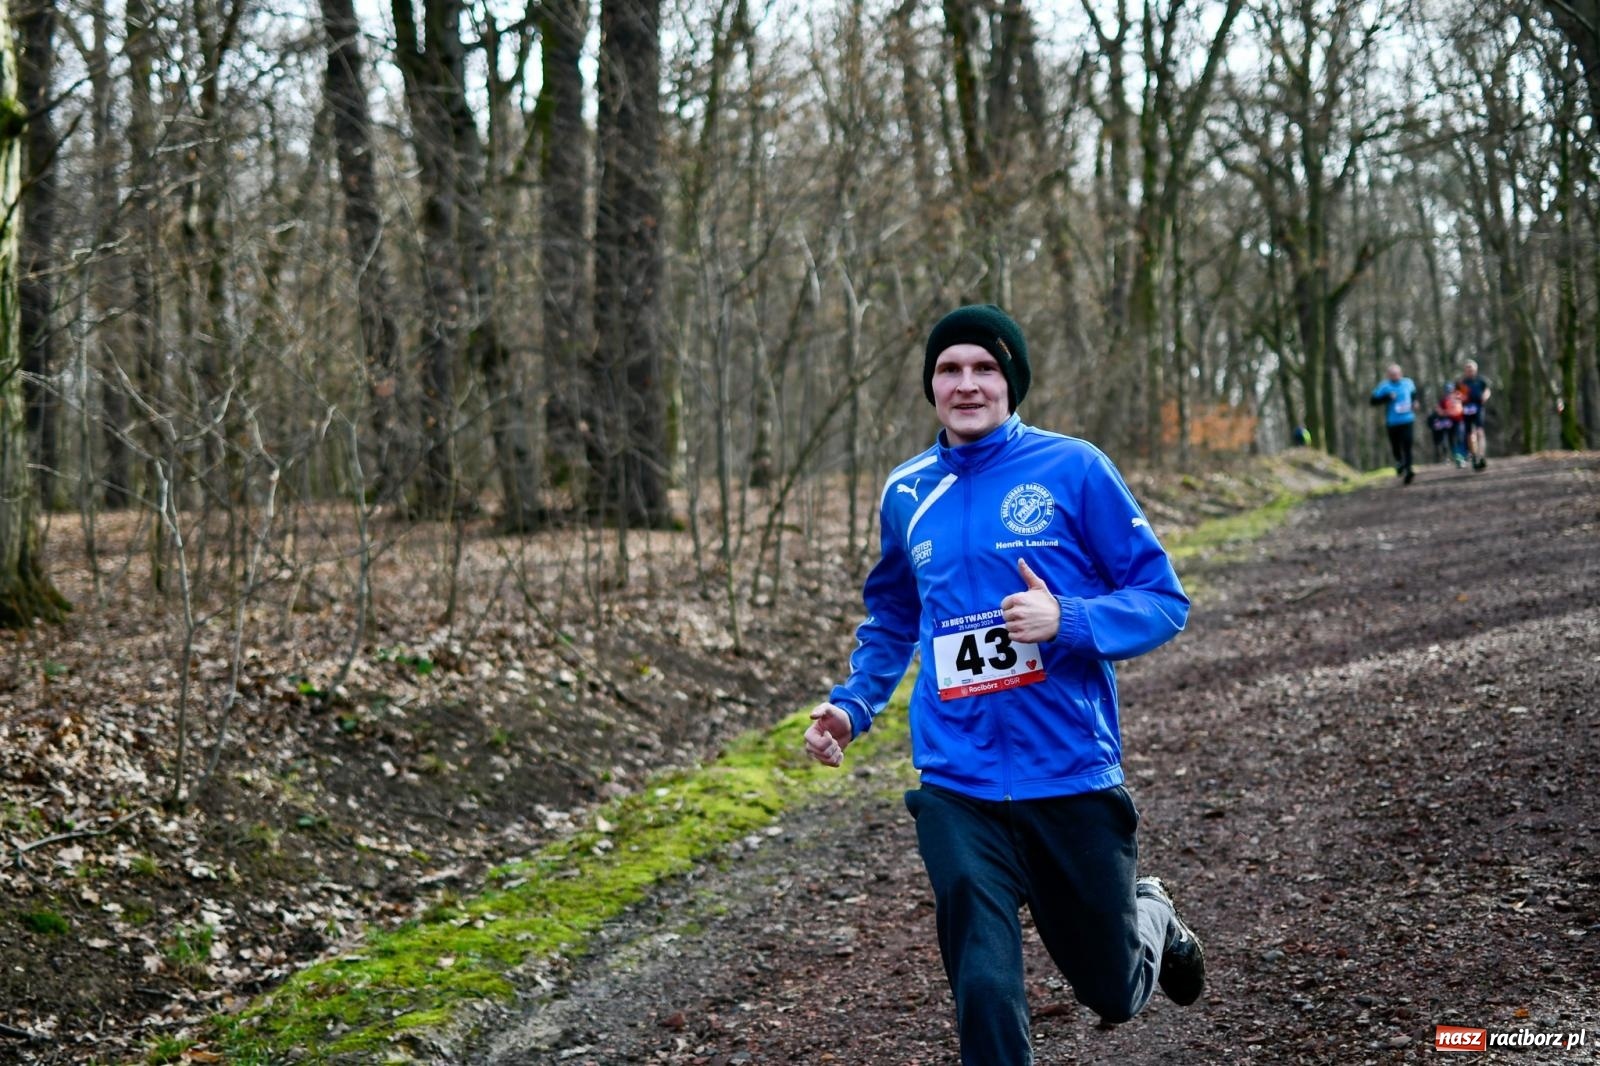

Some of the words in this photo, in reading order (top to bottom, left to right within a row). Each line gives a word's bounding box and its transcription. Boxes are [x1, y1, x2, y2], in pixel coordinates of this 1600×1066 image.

[995, 540, 1024, 550] Henrik
[950, 617, 965, 627] BIEG
[964, 609, 1003, 624] TWARDZI
[955, 627, 1017, 676] 43
